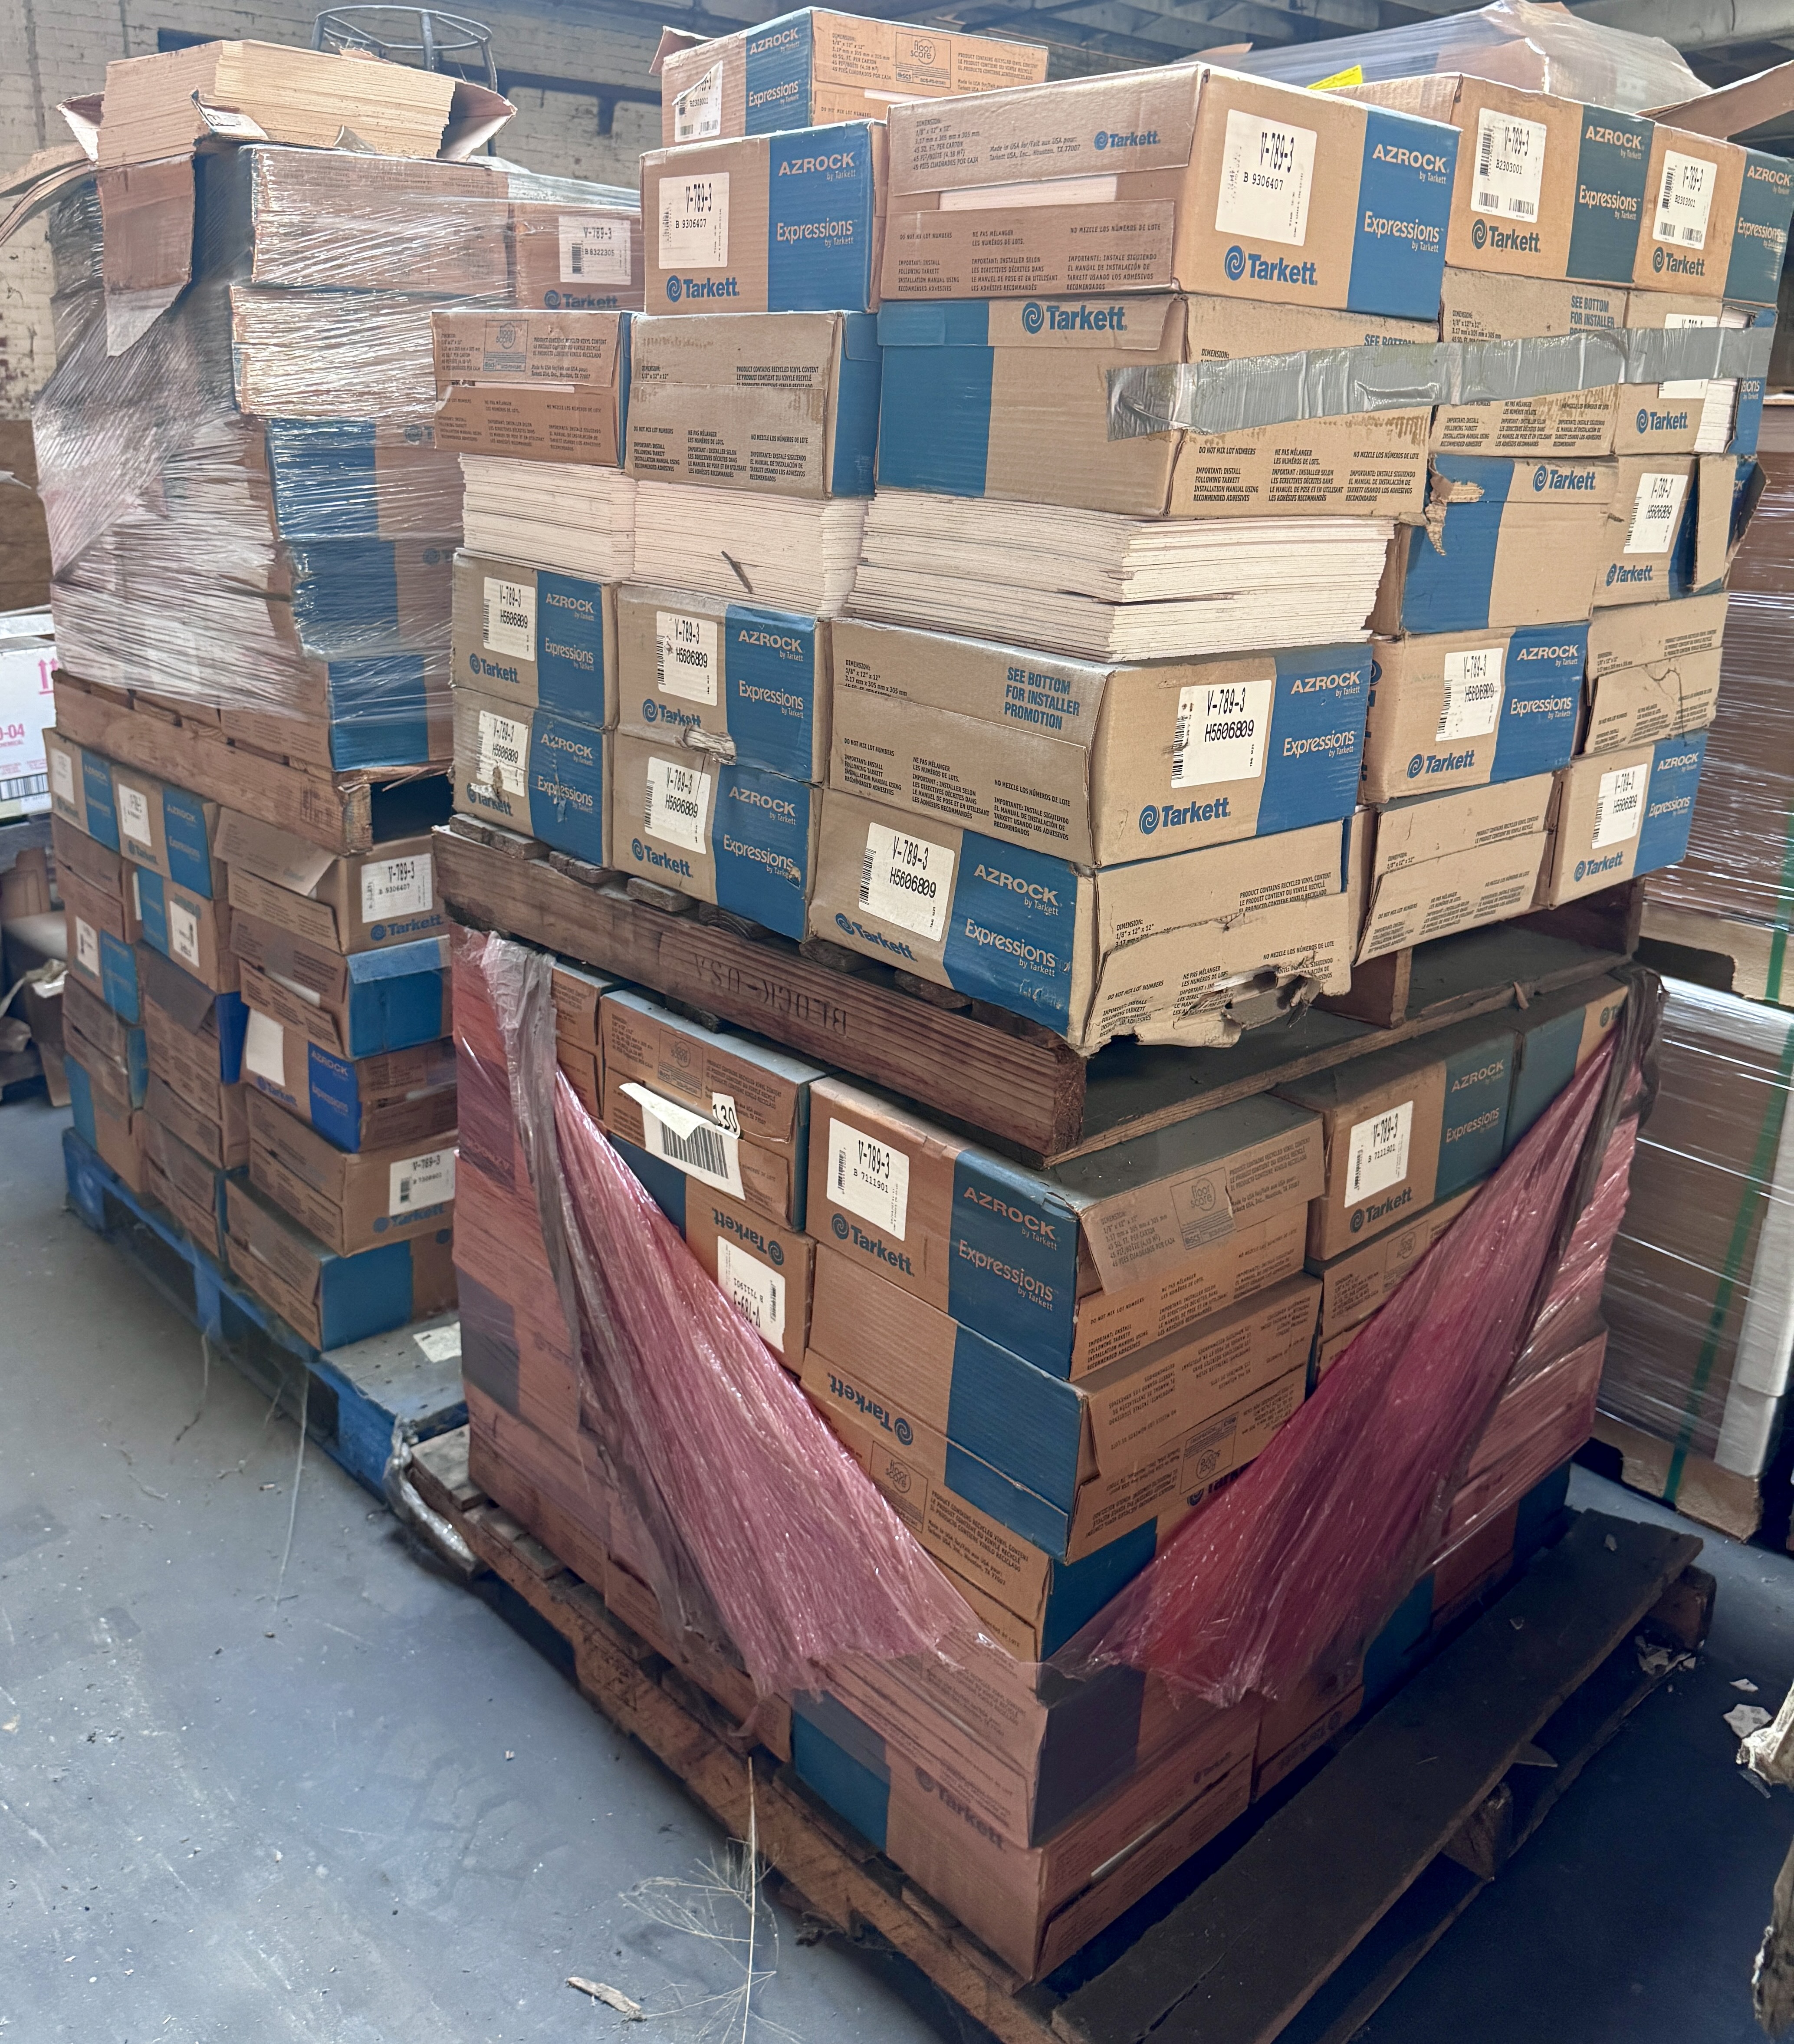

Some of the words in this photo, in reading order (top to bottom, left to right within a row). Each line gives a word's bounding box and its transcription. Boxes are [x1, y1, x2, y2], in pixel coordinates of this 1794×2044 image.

[750, 28, 798, 55] AZROCK
[914, 40, 932, 53] floor
[910, 50, 932, 59] score
[749, 81, 799, 107] Expressions
[1109, 131, 1160, 148] Tarkett
[1505, 127, 1529, 156] V-789-3
[1586, 125, 1642, 150] AZROCK
[779, 152, 854, 176] AZROCK
[1261, 132, 1294, 173] V-789-3
[1373, 144, 1447, 173] AZROCK
[827, 172, 833, 181] by
[835, 170, 856, 179] Tarkett
[1419, 171, 1426, 181] by
[1427, 172, 1446, 184] Tarkett
[1496, 159, 1522, 174] B2303001
[1682, 166, 1703, 191] V-789-3
[1747, 165, 1791, 187] AZROCK
[1244, 172, 1248, 182] B
[1252, 174, 1283, 191] 9306407
[686, 183, 712, 213] V-789-3
[1579, 185, 1637, 211] Expressions
[584, 227, 612, 239] V-789-3
[682, 219, 706, 228] 9306407
[777, 218, 853, 244] Expressions
[1364, 211, 1439, 242] Expressions
[1738, 217, 1784, 241] Expressions
[825, 240, 832, 248] by
[833, 237, 854, 245] Tarkett
[1412, 242, 1418, 251] by
[1419, 242, 1439, 253] Tarkett
[1489, 225, 1540, 253] Tarkett
[1248, 253, 1318, 286] Tarkett
[1666, 252, 1705, 276] Tarkett
[683, 277, 739, 298] Tarkett
[562, 293, 617, 308] Tarkett
[1571, 296, 1582, 308] SEE
[1584, 298, 1608, 313] BOTTOM
[1047, 306, 1126, 331] Tarkett
[1571, 311, 1583, 324] FOR
[1584, 313, 1614, 328] INSTALLER
[1201, 349, 1229, 359] DIMENSION:
[1649, 412, 1687, 430] Tarkett
[1549, 470, 1595, 490] Tarkett
[1616, 566, 1653, 582] Tarkett
[499, 585, 521, 608] V-789-3
[545, 593, 594, 613] AZROCK
[500, 609, 528, 629] H5606809
[675, 619, 699, 645] V-789-3
[739, 630, 802, 653] AZROCK
[545, 638, 594, 664] Expressions
[676, 647, 707, 668] H5606809
[780, 650, 785, 658] by
[787, 651, 803, 662] Tarkett
[1517, 645, 1579, 661] AZROCK
[481, 658, 519, 683] Tarkett
[1464, 655, 1487, 679] V-789-3
[1007, 667, 1025, 684] SEE
[1028, 672, 1071, 695] BOTTOM
[1291, 670, 1360, 694] AZROCK
[1336, 688, 1342, 697] by
[1343, 686, 1360, 695] Tarkett
[739, 680, 803, 710] Expressions
[1006, 685, 1024, 702] FOR
[1028, 688, 1080, 716] INSTALLER
[1207, 687, 1245, 717] V-789-3
[1510, 695, 1572, 717] Expressions
[782, 707, 787, 715] by
[788, 708, 803, 718] Tarkett
[1004, 701, 1062, 730] PROMOTION
[494, 718, 514, 743] V-789-3
[1205, 720, 1254, 742] H5606809
[492, 743, 518, 764] H5606809
[541, 734, 593, 759] AZROCK
[1283, 730, 1355, 759] Expressions
[1329, 749, 1335, 758] by
[1336, 746, 1353, 755] Tarkett
[1425, 750, 1474, 774] Tarkett
[1657, 752, 1699, 771] AZROCK
[667, 767, 693, 794] V-789-3
[729, 787, 795, 816] AZROCK
[1002, 781, 1019, 791] MEZCLE
[1060, 798, 1070, 806] LOTE
[665, 794, 698, 818] H5606809
[1162, 797, 1229, 828] Tarkett
[1649, 797, 1691, 818] Expressions
[769, 812, 775, 820] by
[777, 813, 795, 825] Tarkett
[994, 821, 1029, 836] RECOMENDADOS
[644, 845, 693, 878] Tarkett
[724, 834, 793, 869] Expressions
[891, 836, 929, 870] V-789-3
[1586, 851, 1623, 876] Tarkett
[389, 861, 414, 883] V-789-3
[890, 867, 936, 899] H5606809
[974, 864, 1058, 906] AZROCK
[1240, 889, 1258, 898] PRODUCT
[1260, 884, 1280, 894] CONTAINS
[1281, 879, 1301, 890] RECYCLED
[1301, 876, 1313, 885] VINYL
[1314, 872, 1331, 882] CONTENT
[1024, 897, 1033, 908] by
[1034, 899, 1058, 916] Tarkett
[388, 915, 443, 935] Tarkett
[1117, 919, 1143, 931] DIMENSION:
[852, 922, 916, 961] Tarkett
[966, 918, 1055, 968] Expressions
[1019, 958, 1027, 969] by
[1030, 961, 1055, 977] Tarkett
[1452, 1060, 1504, 1093] AZROCK
[1373, 1113, 1398, 1147] V-789-3
[1446, 1108, 1499, 1143] Expressions
[858, 1139, 890, 1179] V-789-3
[861, 1172, 888, 1193] 7111901
[1191, 1184, 1210, 1197] floor
[964, 1187, 1055, 1240] AZROCK
[1191, 1195, 1212, 1208] score
[1366, 1187, 1412, 1222] Tarkett
[713, 1208, 767, 1254] Tarkett
[1022, 1228, 1030, 1238] by
[1032, 1232, 1057, 1251] Tarkett
[851, 1225, 914, 1277] Tarkett
[959, 1240, 1053, 1301] Expressions
[1018, 1286, 1026, 1297] by
[1028, 1290, 1052, 1311] Tarkett
[828, 1373, 893, 1432] Tarkett
